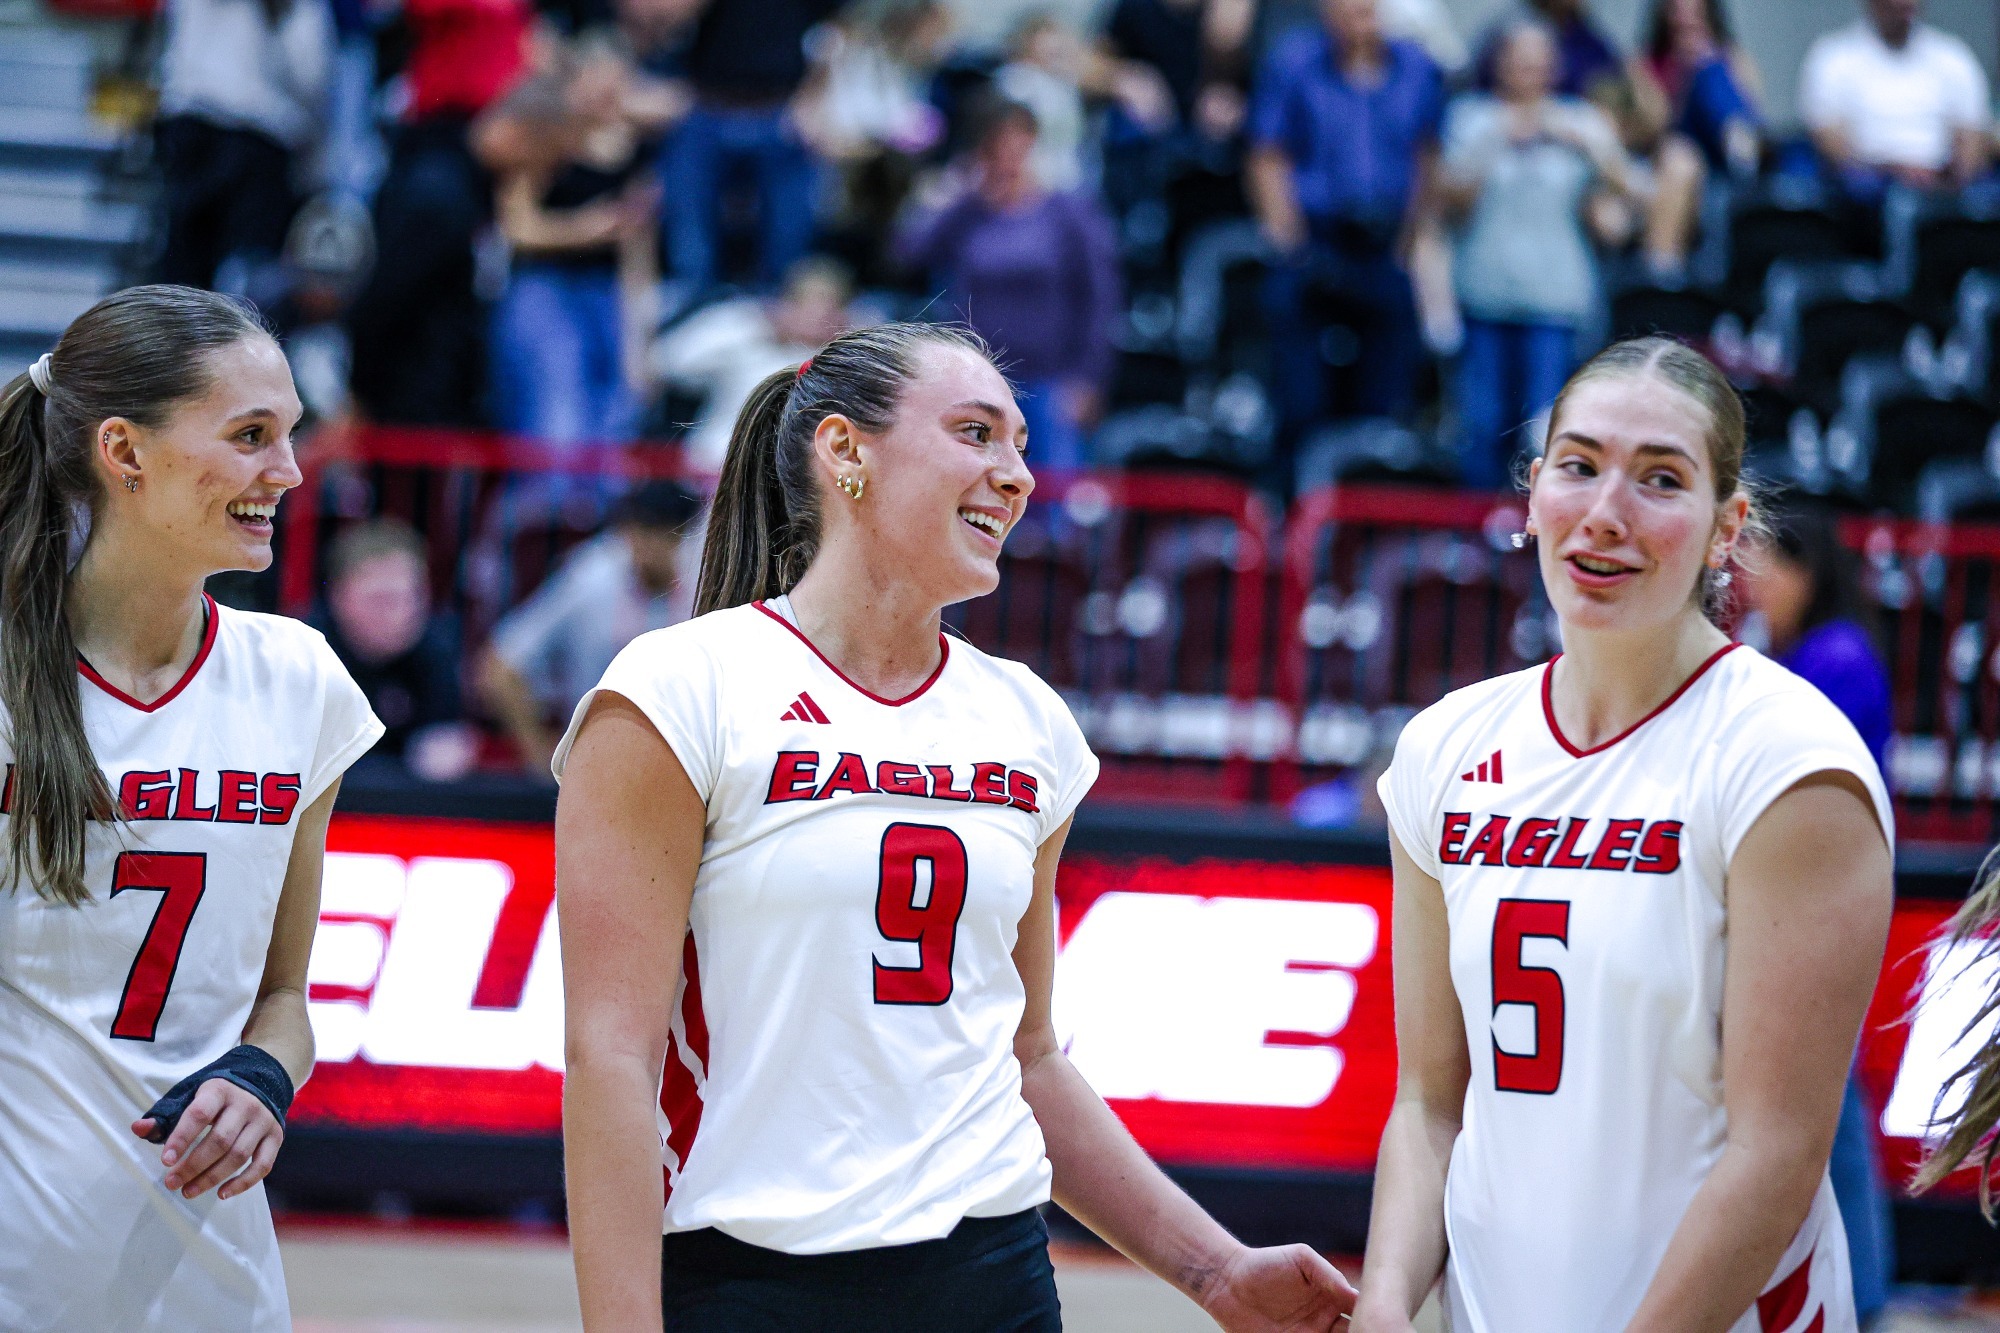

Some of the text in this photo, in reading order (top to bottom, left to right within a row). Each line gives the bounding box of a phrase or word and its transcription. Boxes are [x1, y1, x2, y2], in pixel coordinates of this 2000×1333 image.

[0, 763, 301, 825] GLES
[764, 750, 1040, 814] EAGLES
[1439, 812, 1683, 875] EAGLES
[110, 850, 207, 1042] 7
[873, 822, 968, 1006] 9
[1491, 898, 1571, 1095] 5
